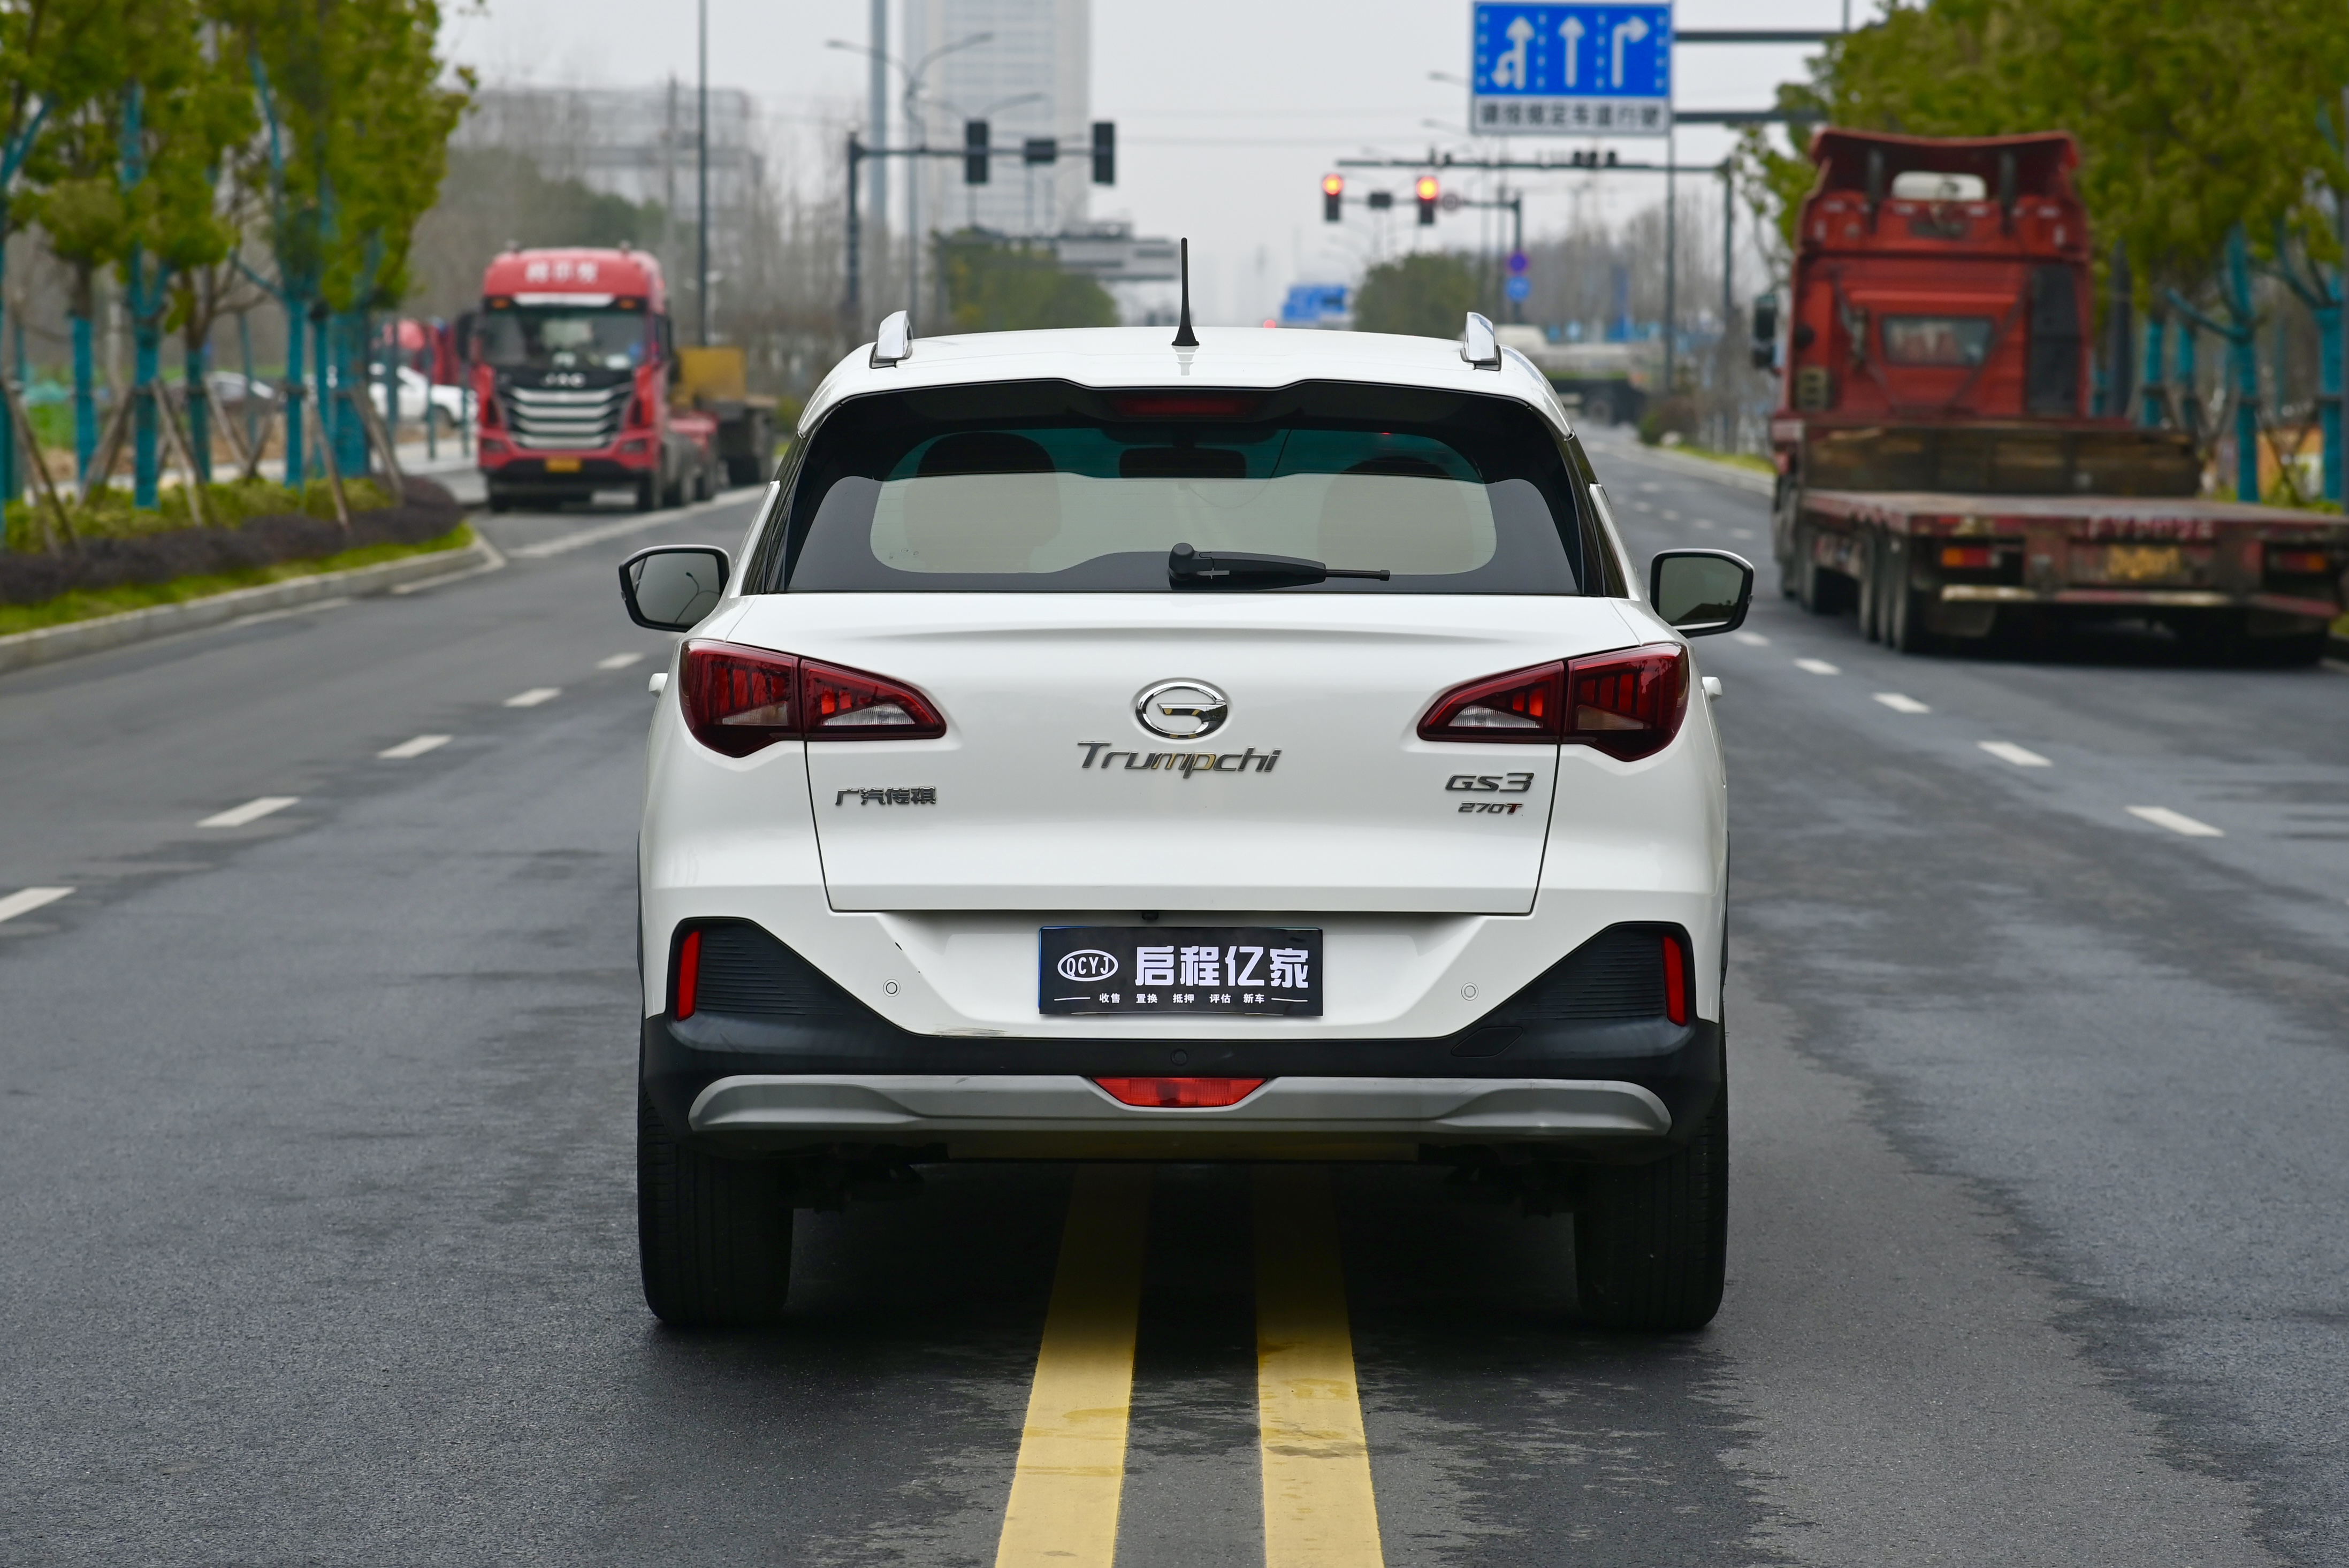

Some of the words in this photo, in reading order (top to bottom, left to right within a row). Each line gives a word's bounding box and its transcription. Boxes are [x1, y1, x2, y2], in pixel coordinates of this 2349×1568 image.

[1077, 740, 1282, 779] Trumpchi
[1445, 772, 1535, 793] GS3
[835, 786, 937, 806] 广汽传祺
[1458, 801, 1524, 815] 270T
[1065, 956, 1110, 976] QCYJ
[1135, 945, 1309, 988] 启程亿家
[1099, 993, 1120, 1004] 收售
[1136, 993, 1158, 1004] 置换
[1172, 993, 1194, 1004] 抵押
[1209, 993, 1231, 1004] 评估
[1243, 993, 1265, 1004] 新车
